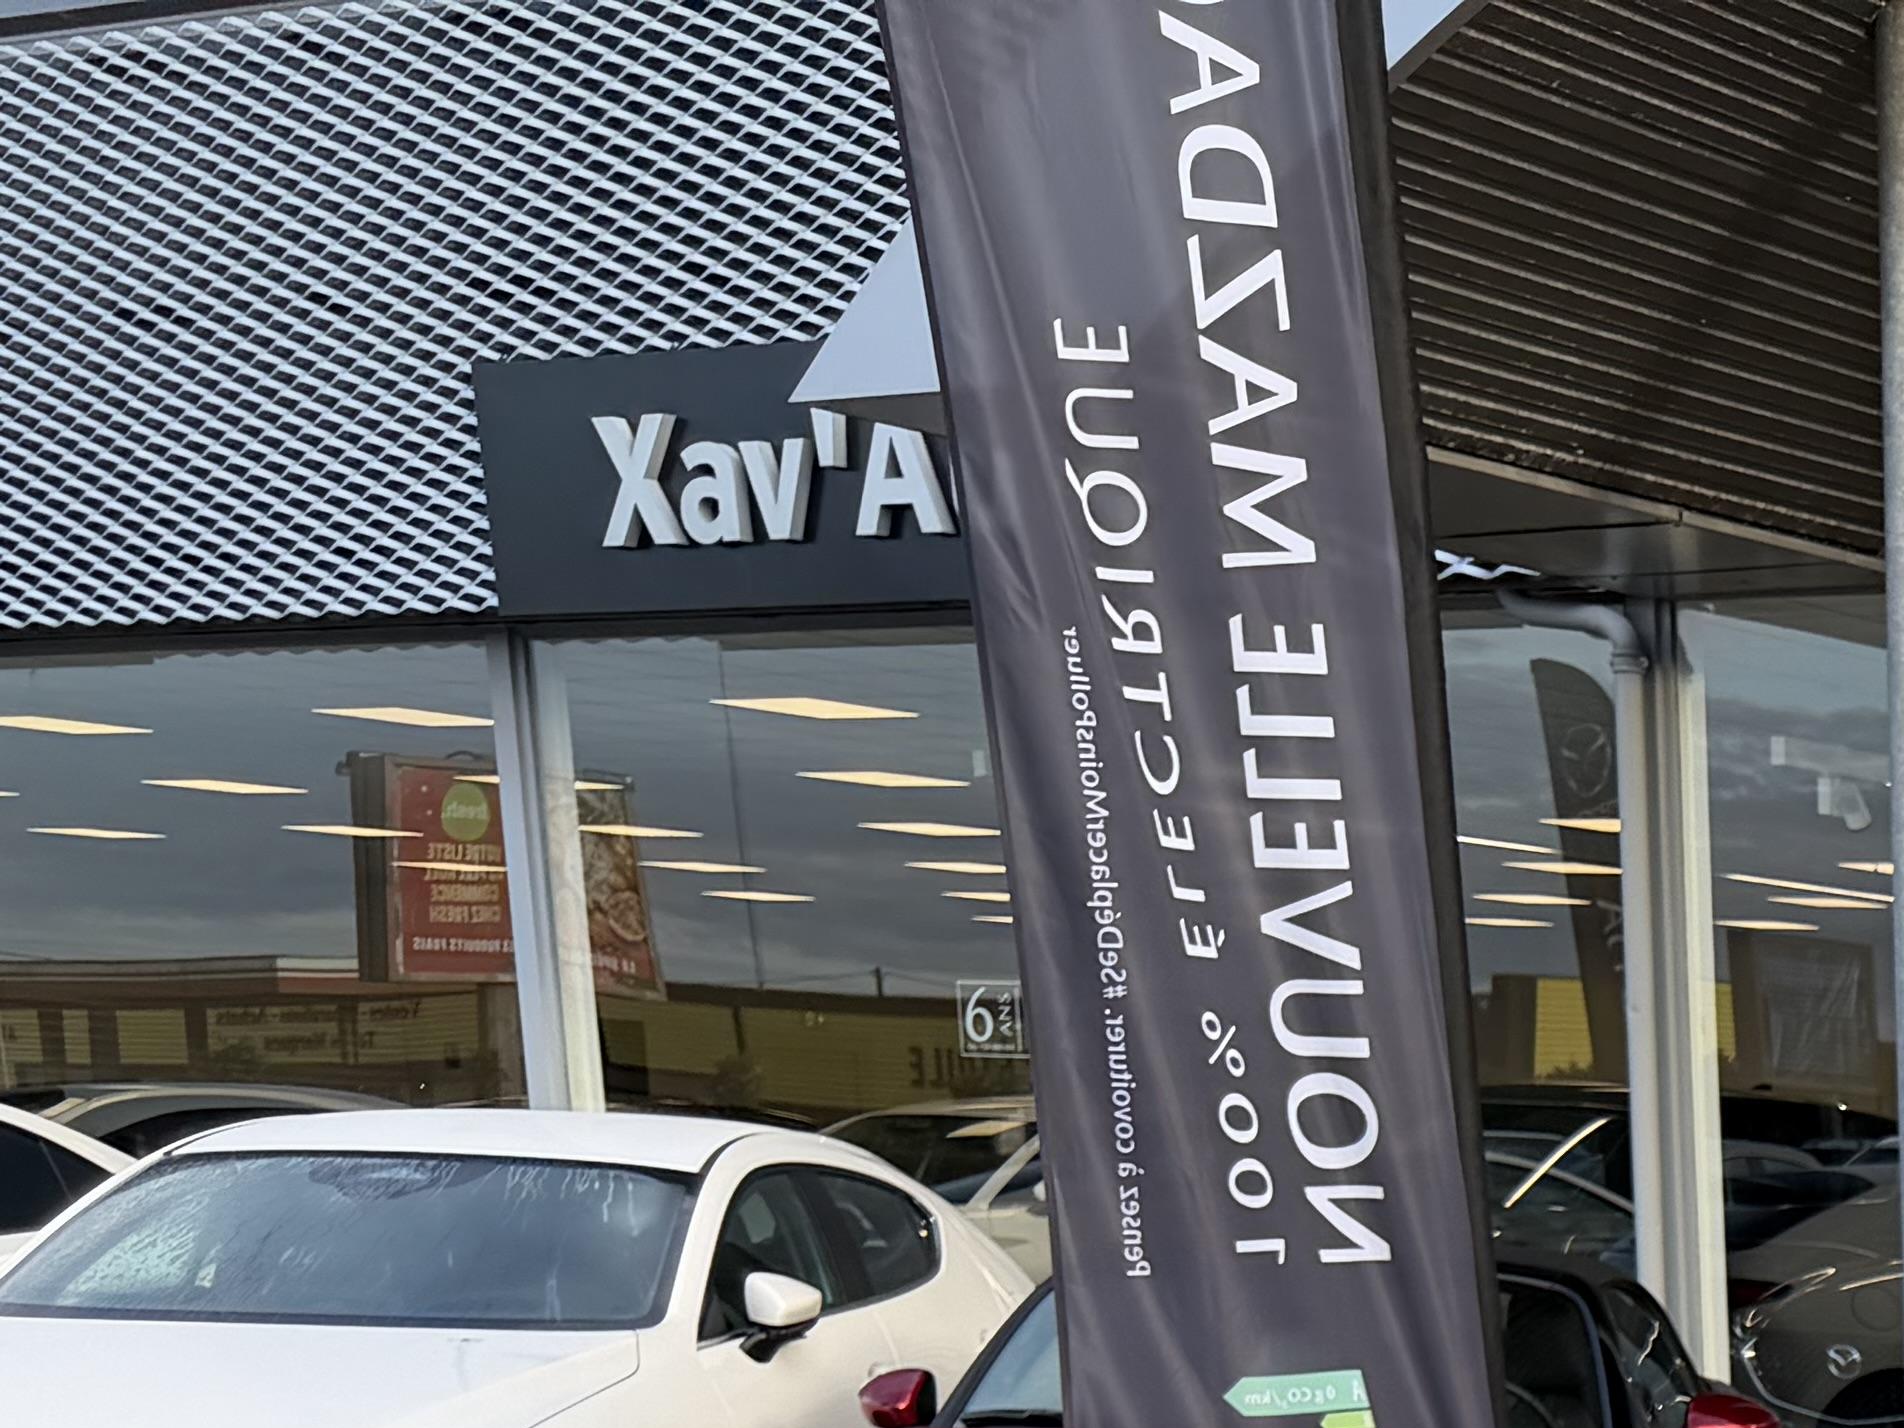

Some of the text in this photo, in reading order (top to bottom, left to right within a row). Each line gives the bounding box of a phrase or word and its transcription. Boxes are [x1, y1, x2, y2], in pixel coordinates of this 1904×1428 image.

[591, 407, 961, 549] Xav'A
[964, 985, 1014, 1043] 6 ANS
